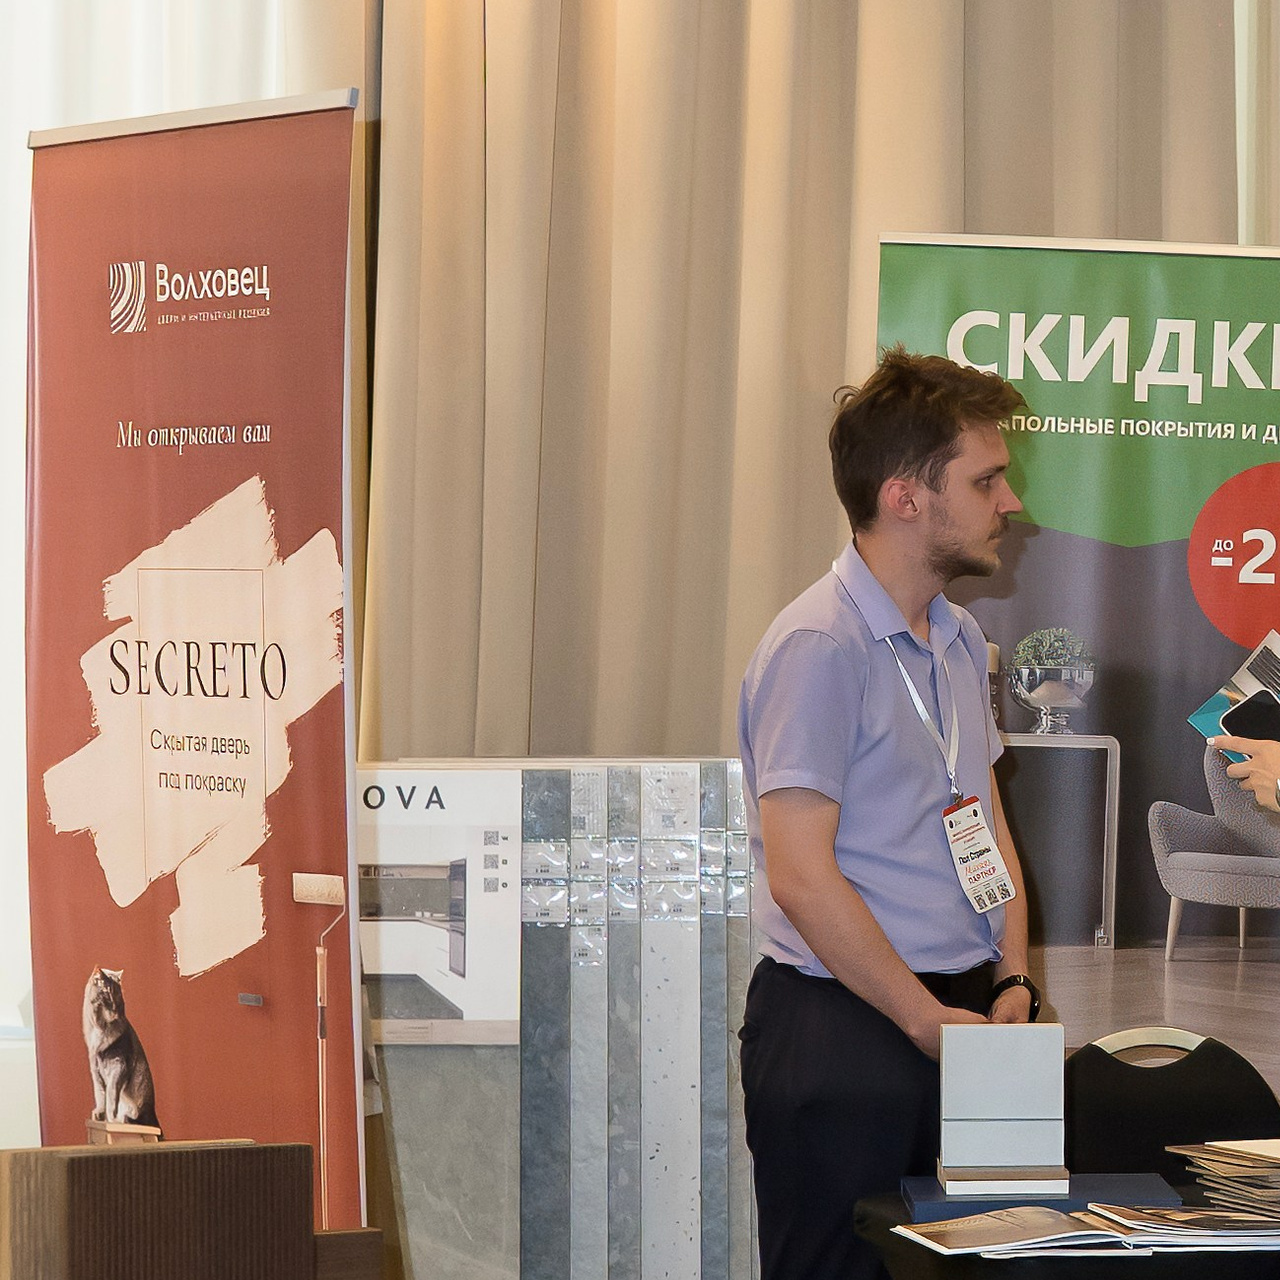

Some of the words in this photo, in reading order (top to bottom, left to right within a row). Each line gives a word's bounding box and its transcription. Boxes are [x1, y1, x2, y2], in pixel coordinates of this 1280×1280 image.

[155, 263, 270, 302] Волховец
[147, 424, 236, 456] открываем
[242, 424, 271, 443] вам
[1120, 419, 1235, 439] ПОКРЫТИЯ
[1241, 423, 1257, 440] И
[108, 639, 287, 701] SECRETO
[150, 728, 208, 756] Скрытая
[211, 735, 251, 759] дверь
[158, 772, 181, 792] под
[185, 773, 247, 799] покраску
